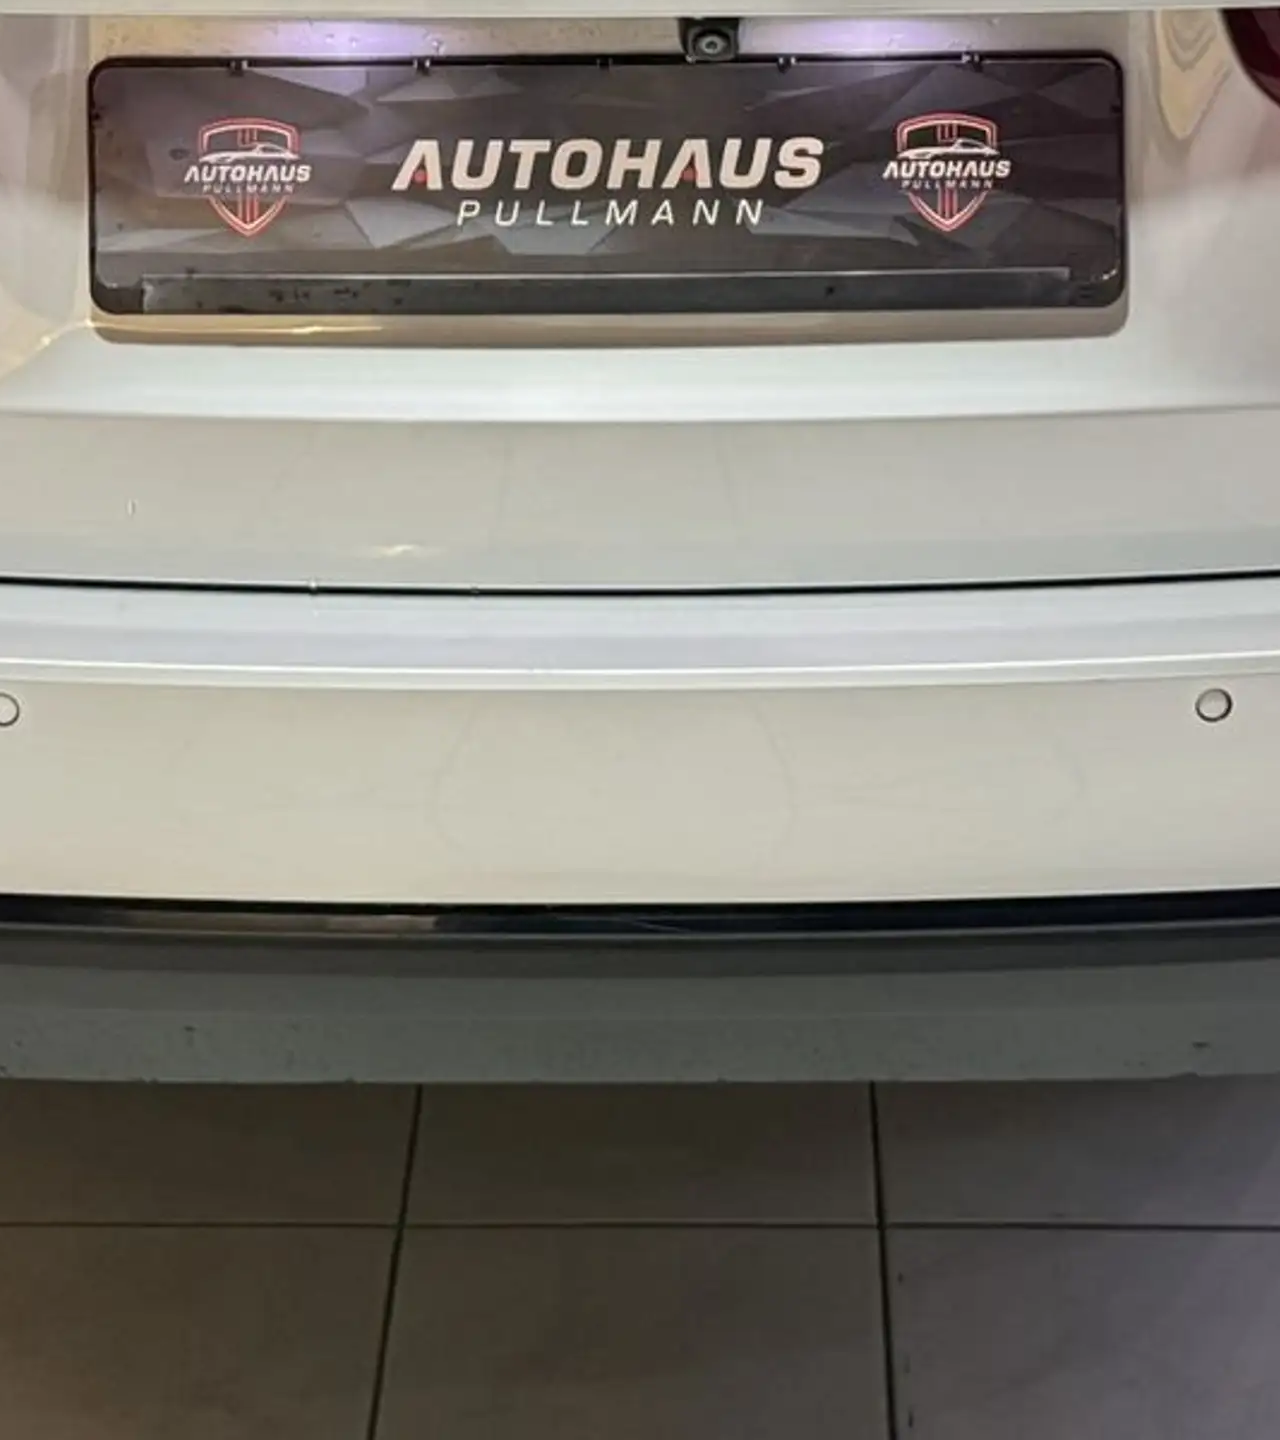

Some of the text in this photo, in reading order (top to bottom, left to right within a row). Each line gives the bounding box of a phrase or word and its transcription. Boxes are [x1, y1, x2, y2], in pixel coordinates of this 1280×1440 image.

[392, 136, 825, 191] AUTOHAUS
[882, 159, 1012, 179] AUTOHAUS
[183, 164, 313, 183] AUTOHAUS
[202, 183, 295, 194] PULLMANN
[900, 179, 994, 190] PULLMANN
[456, 199, 765, 227] PULLMANN
